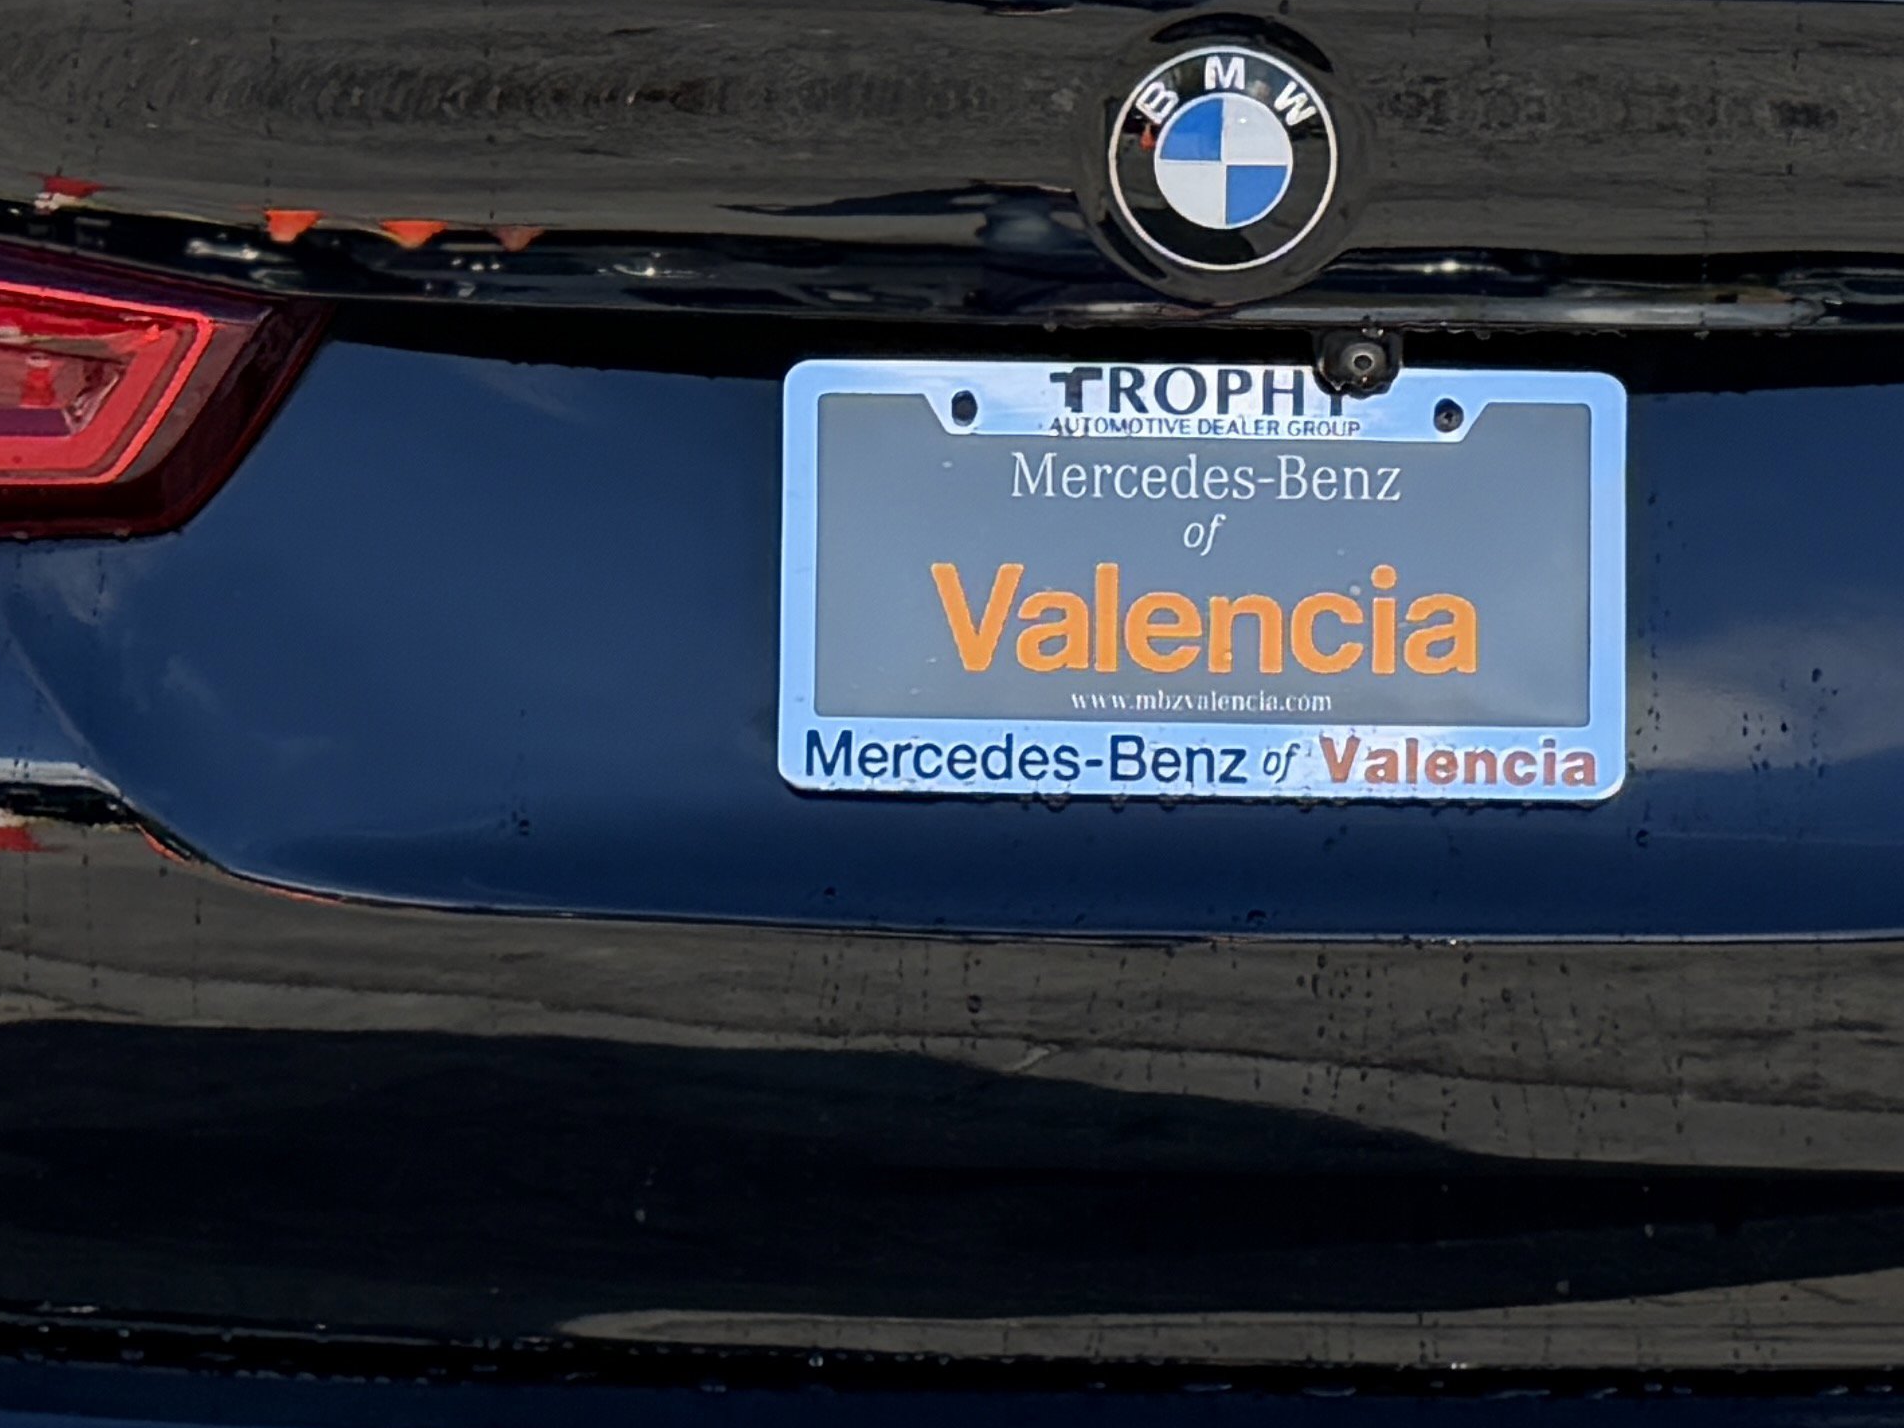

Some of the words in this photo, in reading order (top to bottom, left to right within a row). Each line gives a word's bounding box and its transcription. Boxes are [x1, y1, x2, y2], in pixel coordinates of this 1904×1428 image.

[1135, 56, 1317, 126] BMW
[1050, 416, 1191, 436] AUTOMOTIVE
[1197, 418, 1280, 436] DEALER
[1286, 420, 1361, 437] GROUP
[1011, 451, 1401, 502] Mercedes-Benz
[1183, 513, 1227, 556] of
[930, 562, 1478, 675] Valencia
[1071, 690, 1333, 713] www.mbzvalencia.com
[805, 729, 1247, 785] Mercedes-Benz
[1261, 743, 1300, 784] of
[1319, 735, 1598, 787] Valencia
